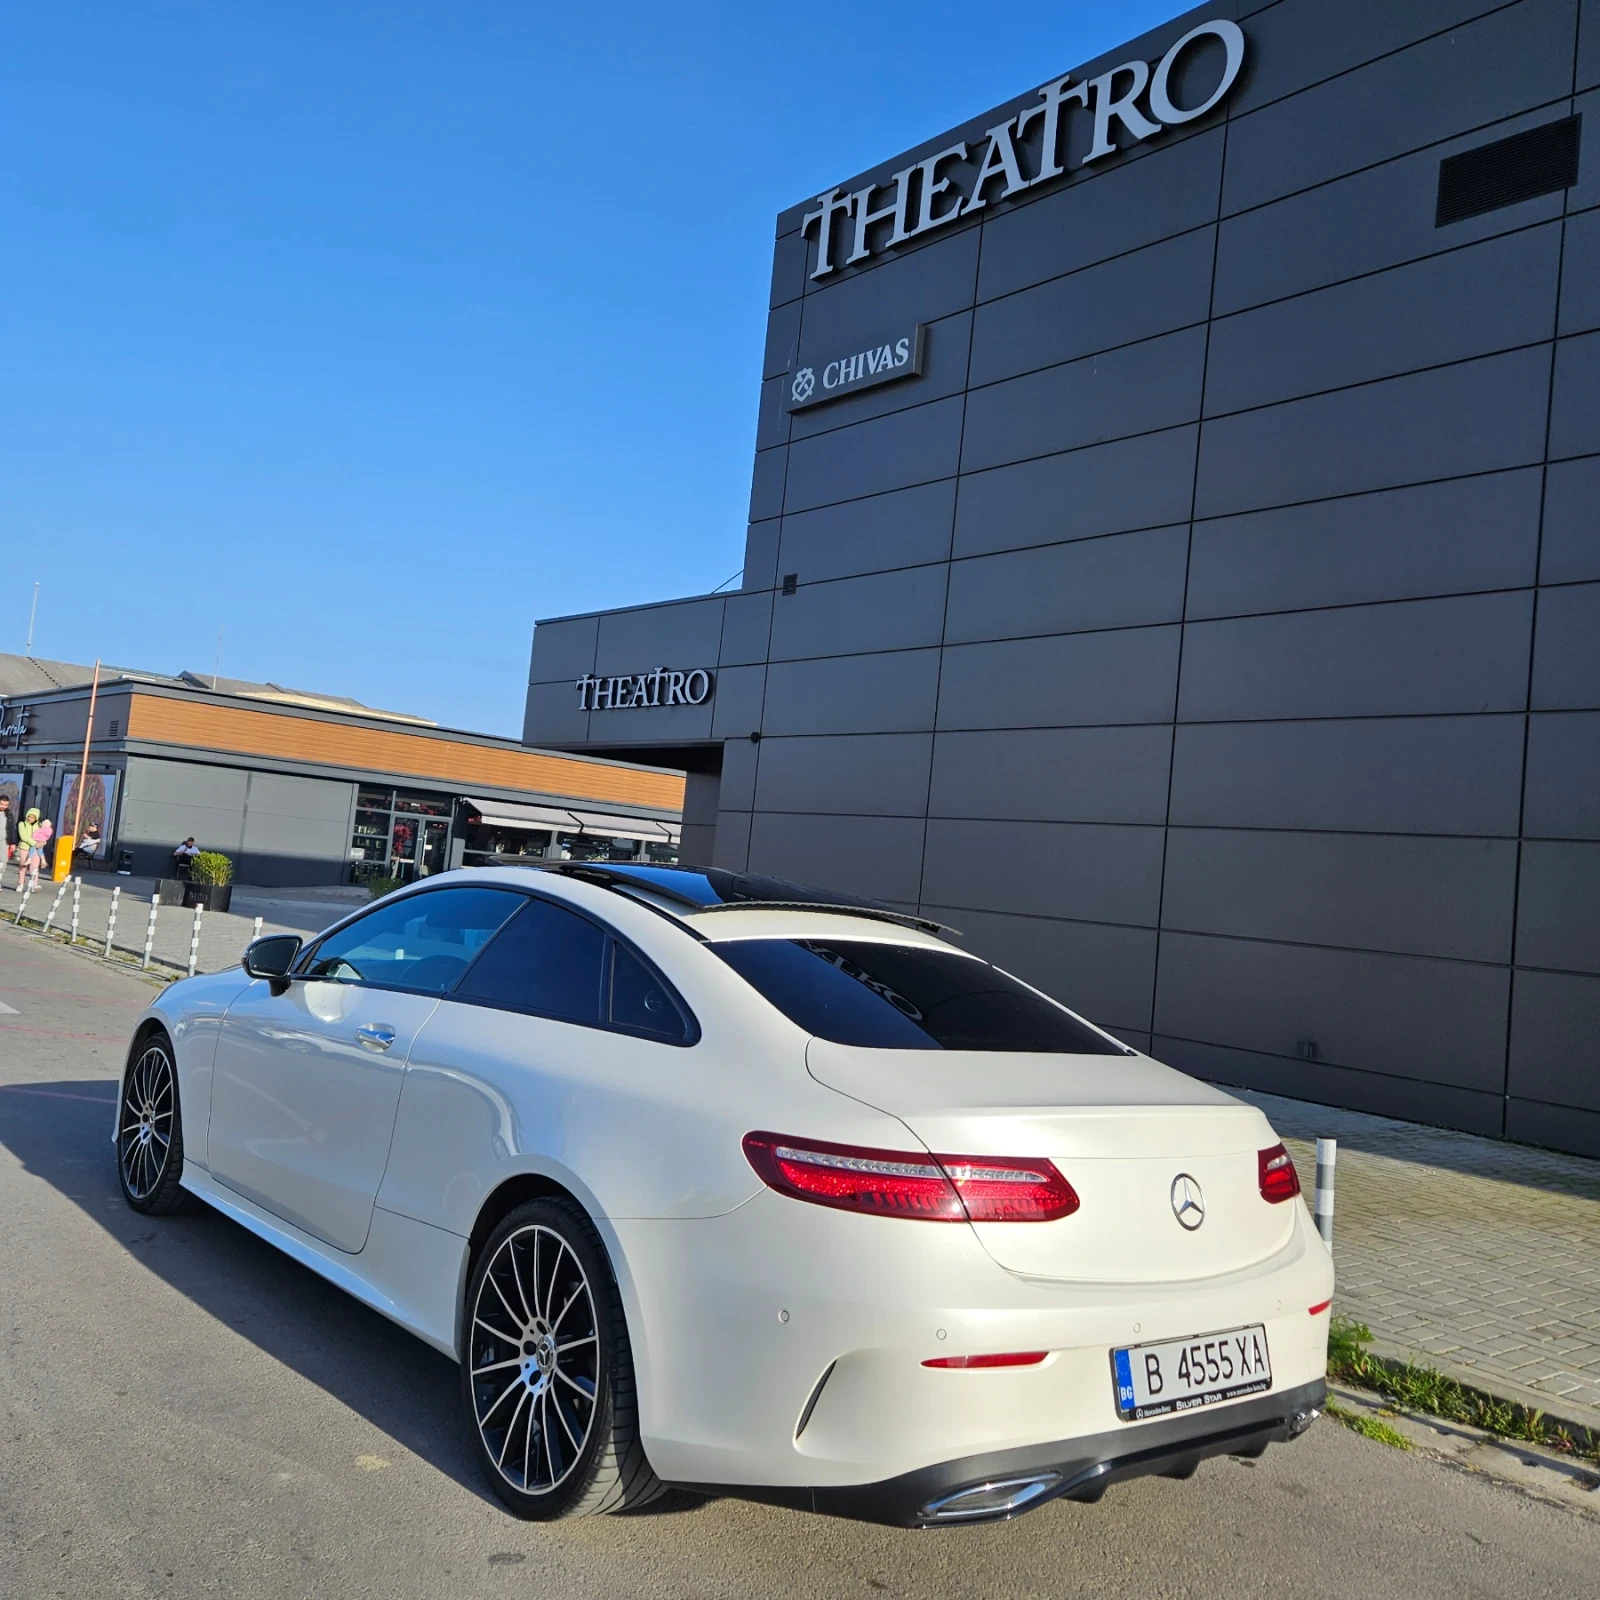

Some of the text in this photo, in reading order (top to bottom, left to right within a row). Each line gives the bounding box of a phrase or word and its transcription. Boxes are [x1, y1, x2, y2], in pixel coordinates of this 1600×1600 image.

[801, 19, 1245, 281] THEATRO
[822, 338, 909, 389] CHIVAS
[576, 666, 709, 710] THEATRO
[1145, 1334, 1265, 1396] B 4555 XA
[1120, 1387, 1133, 1400] BG
[1176, 1397, 1203, 1410] SILVER
[1204, 1393, 1223, 1404] STAR
